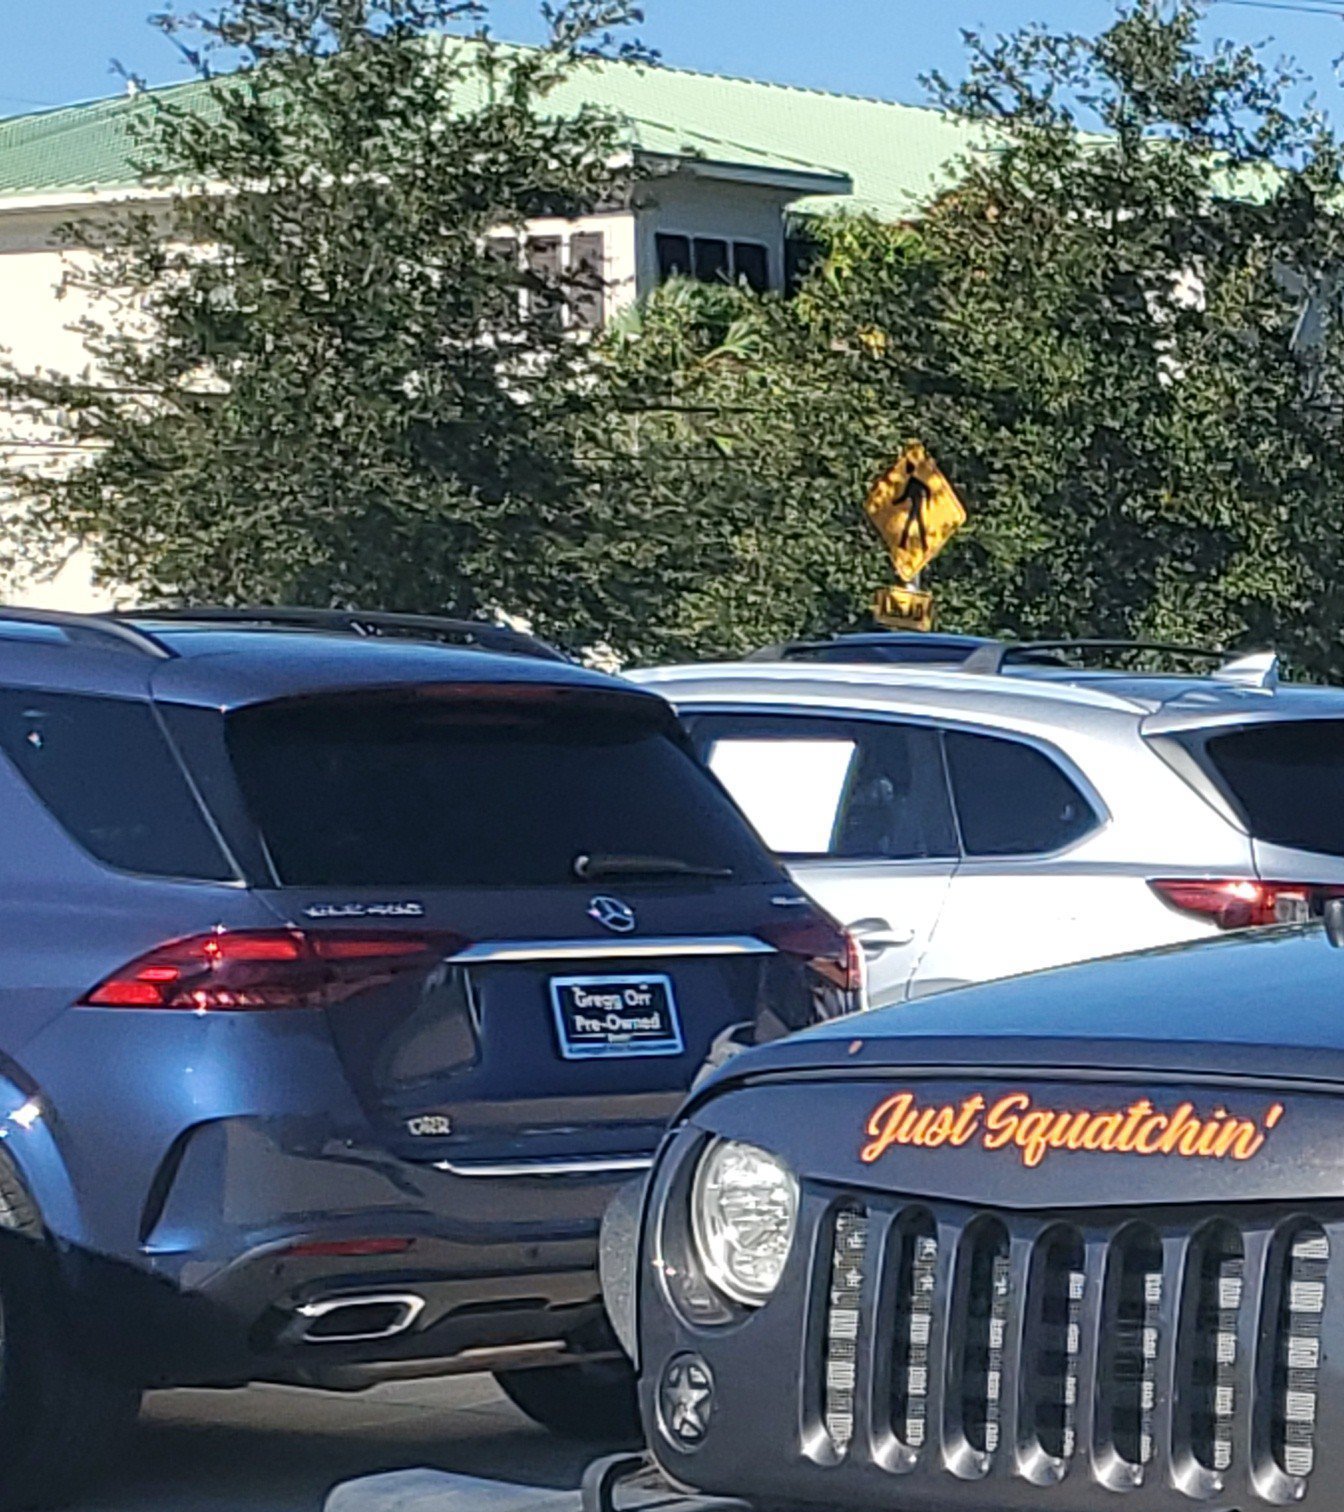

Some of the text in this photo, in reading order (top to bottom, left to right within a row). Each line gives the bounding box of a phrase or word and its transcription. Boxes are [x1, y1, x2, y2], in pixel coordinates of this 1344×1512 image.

[574, 1012, 662, 1032] Pre-Owned
[861, 1092, 1285, 1167] Just Squatchin'
